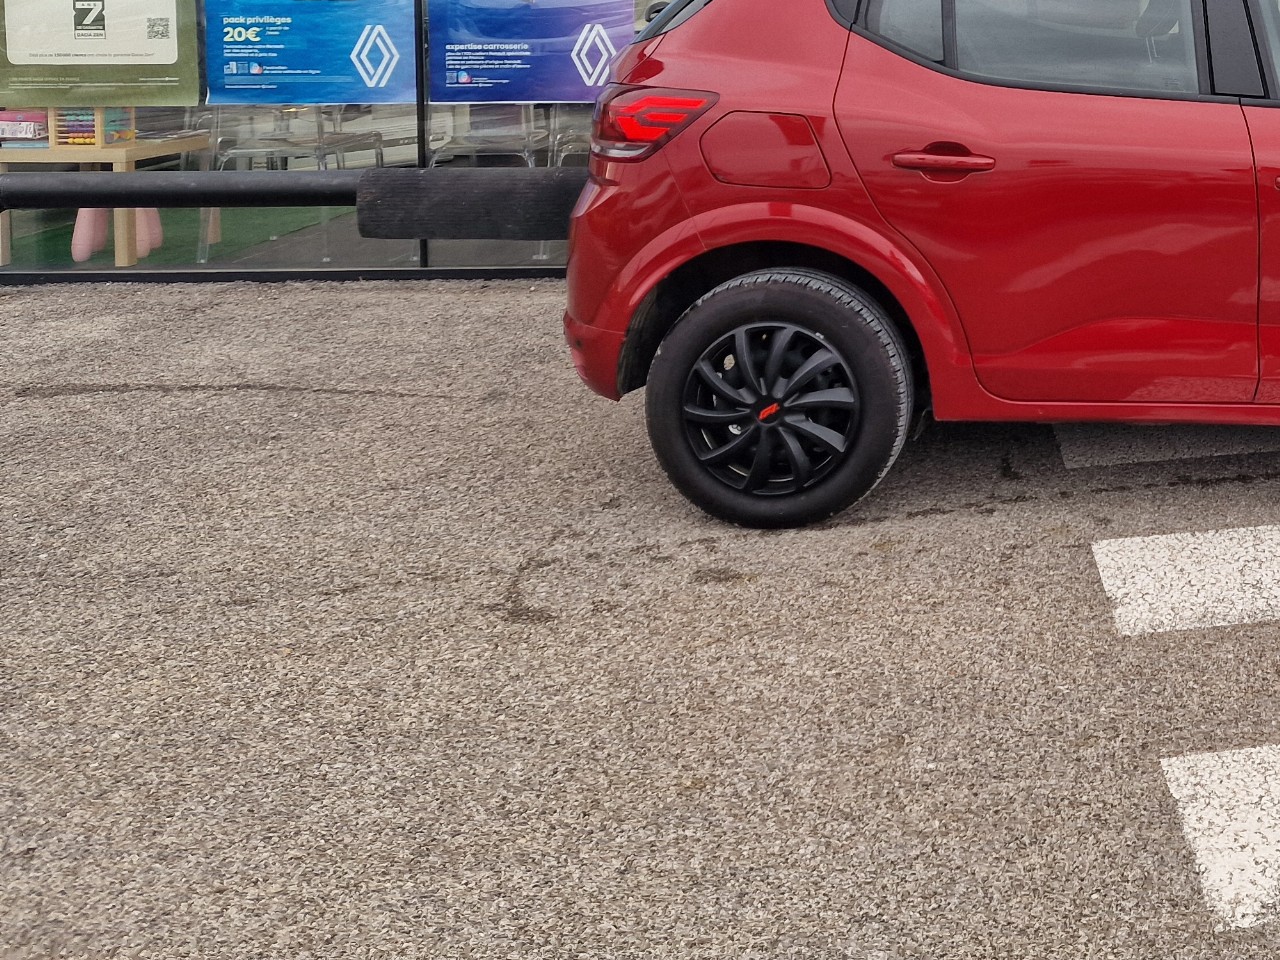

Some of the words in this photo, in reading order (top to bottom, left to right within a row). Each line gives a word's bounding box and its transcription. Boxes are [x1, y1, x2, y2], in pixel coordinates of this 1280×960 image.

[223, 16, 246, 24] pack
[246, 16, 292, 25] privilèges
[223, 26, 262, 42] 20€
[445, 43, 482, 51] expertise
